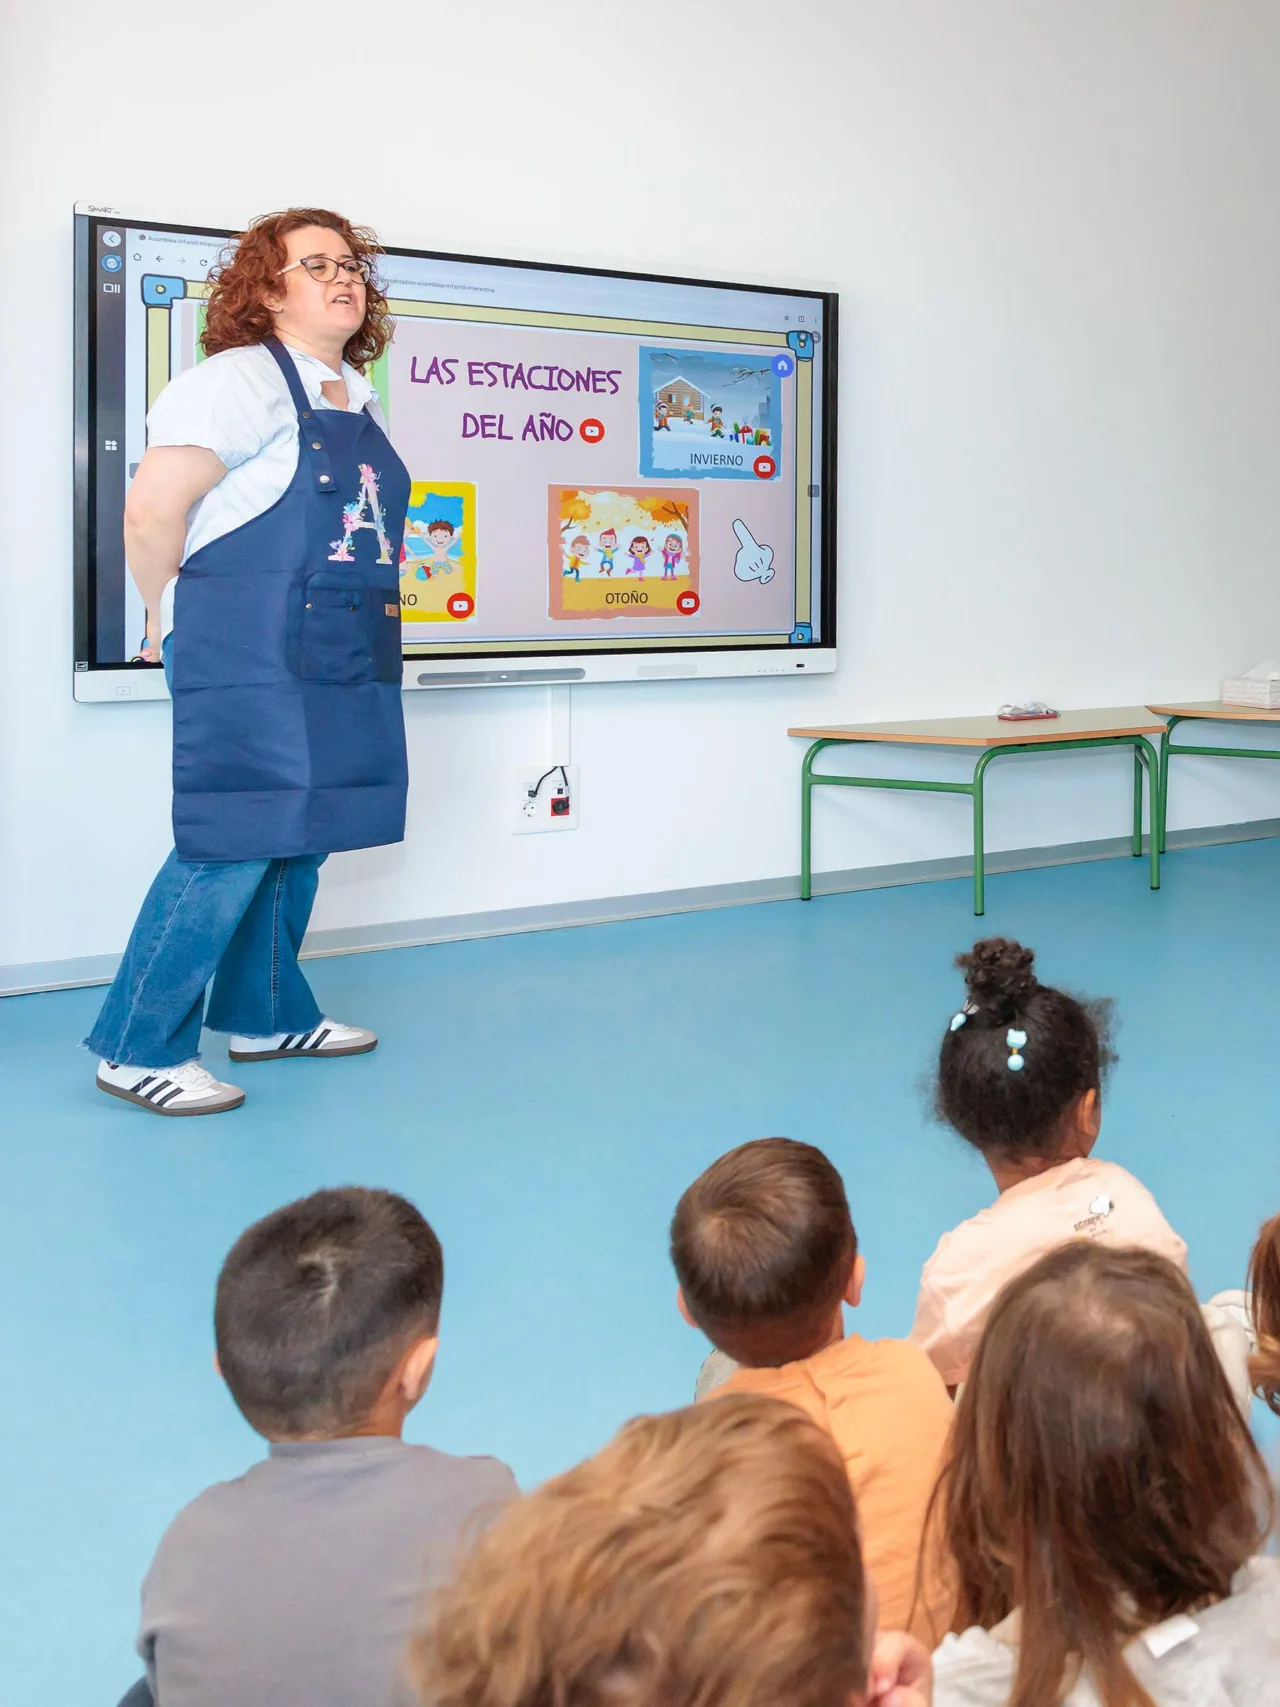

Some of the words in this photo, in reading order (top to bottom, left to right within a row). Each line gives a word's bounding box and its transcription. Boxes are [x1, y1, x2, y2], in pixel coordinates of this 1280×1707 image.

[88, 205, 114, 214] SMART
[411, 356, 459, 385] LAS
[467, 362, 622, 395] ESTACIONES
[462, 412, 513, 441] DEL
[522, 411, 574, 442] AÑO
[690, 453, 744, 466] INVIERNO
[328, 463, 394, 565] A
[605, 590, 649, 604] OTOÑO
